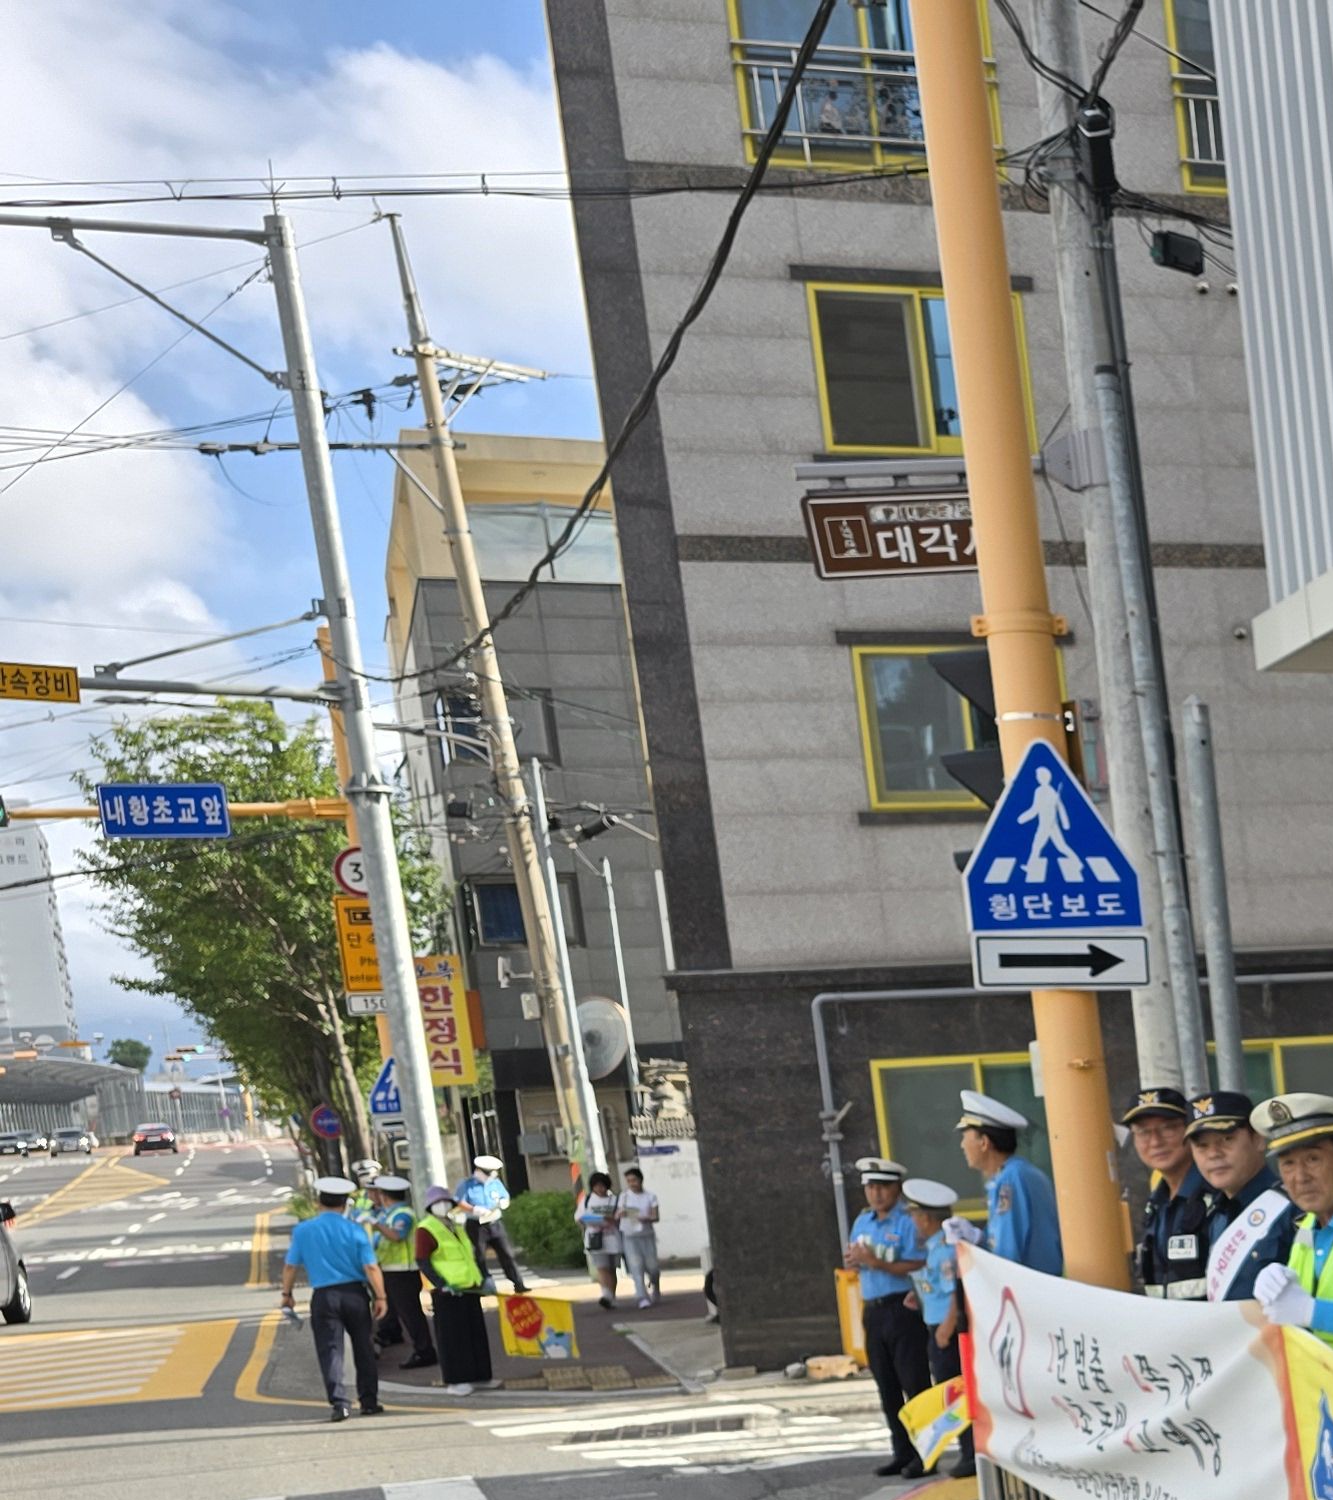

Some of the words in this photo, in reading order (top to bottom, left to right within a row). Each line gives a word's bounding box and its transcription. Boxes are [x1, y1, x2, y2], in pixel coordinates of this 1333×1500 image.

[105, 794, 223, 827] 내황초교앞
[350, 862, 365, 883] 3
[988, 892, 1126, 920] 횡단보도
[419, 985, 462, 1076] 한정식
